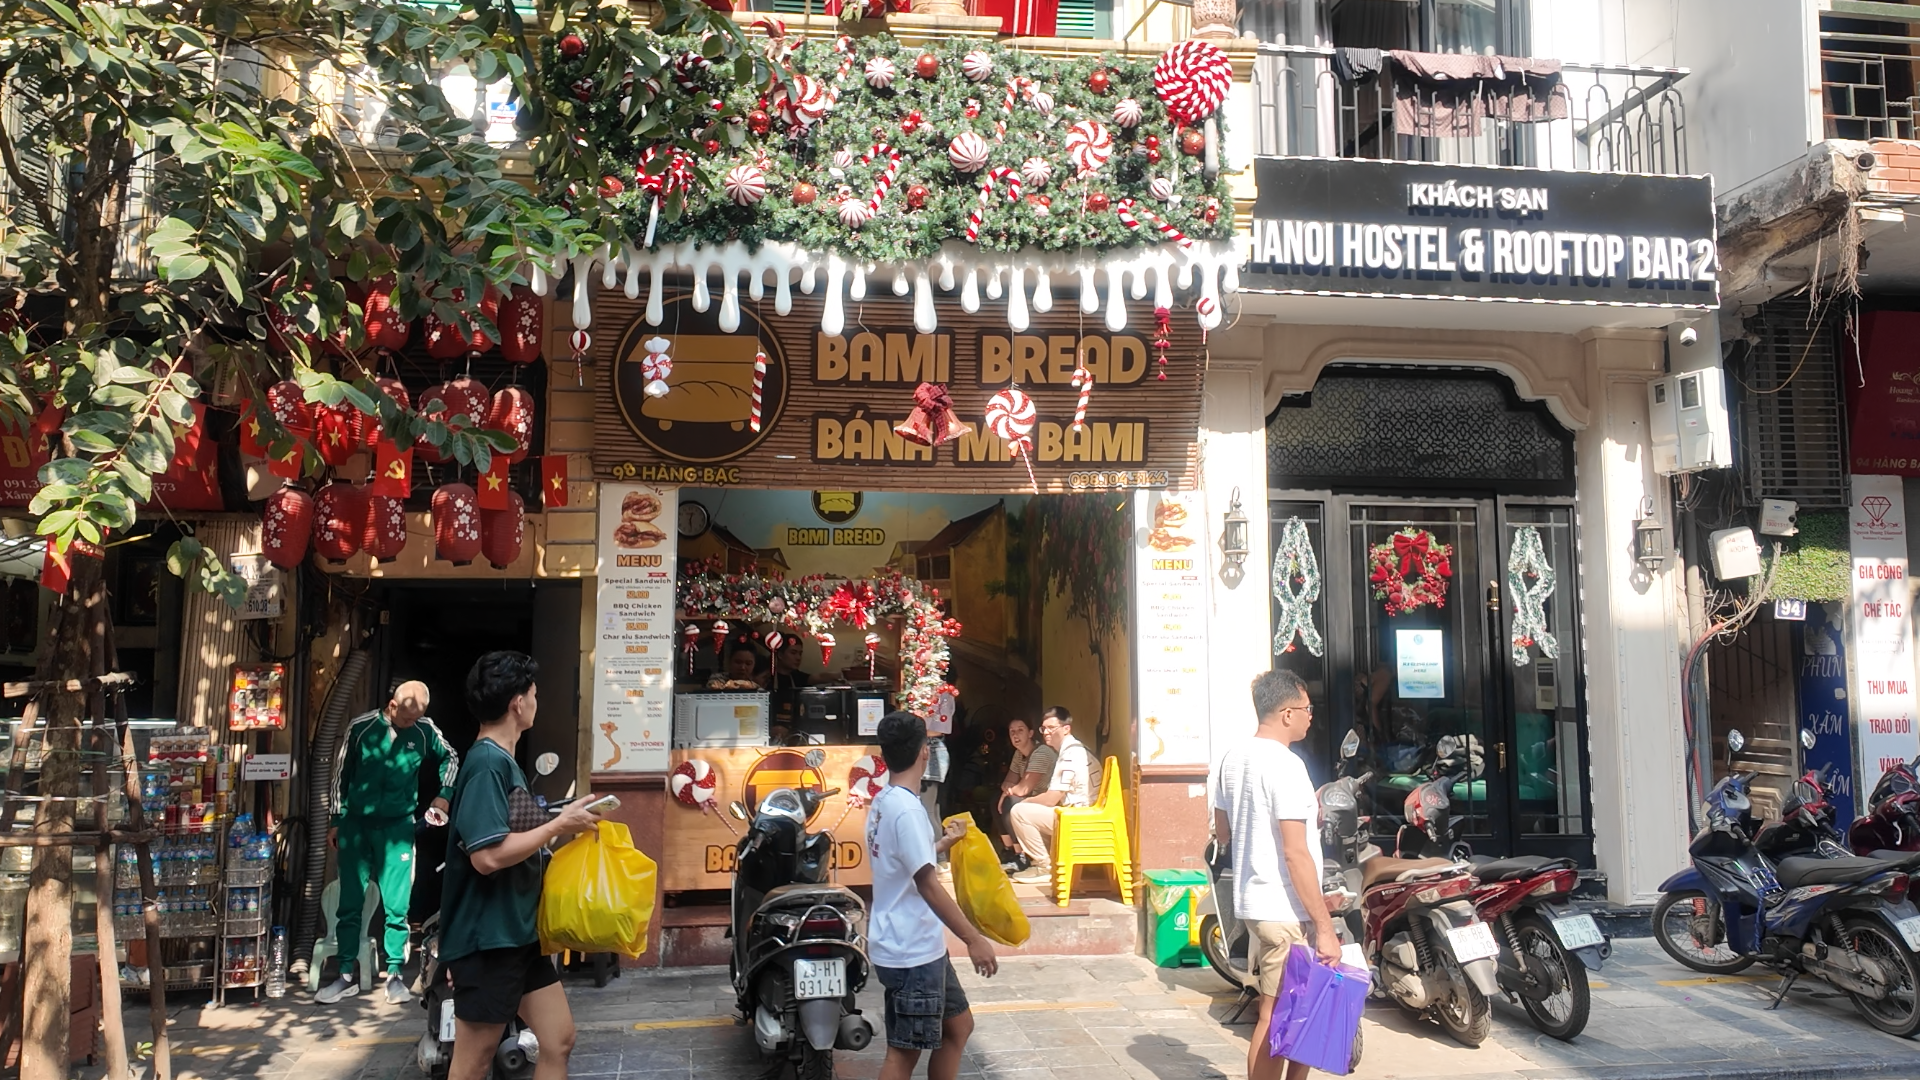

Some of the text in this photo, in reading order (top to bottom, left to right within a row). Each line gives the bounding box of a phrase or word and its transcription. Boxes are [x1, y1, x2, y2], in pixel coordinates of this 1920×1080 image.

[1410, 180, 1548, 215] KHÁCH SẠN
[1343, 223, 1456, 272] HOSTEL
[1463, 227, 1484, 272] &
[1494, 229, 1624, 278] ROOFTOP
[1632, 236, 1689, 280] BAR
[1691, 238, 1717, 280] 2
[817, 331, 1147, 384] BAMI BREAD
[1038, 421, 1144, 462] BAMI
[1872, 456, 1907, 468] HÀNG
[612, 463, 740, 487] 98 HÀNG BẠC
[788, 528, 885, 545] BAMI BREAD
[617, 555, 662, 567] MENU
[1152, 559, 1193, 571] MENU
[1859, 562, 1902, 579] GIA CÔNG
[1781, 600, 1801, 616] 94
[1864, 598, 1902, 617] CHẾ TÁC
[1867, 680, 1908, 694] THU MUA
[1809, 710, 1842, 735] XĂM
[1869, 713, 1911, 734] TRAO ĐỔI
[799, 981, 843, 996] 931.41
